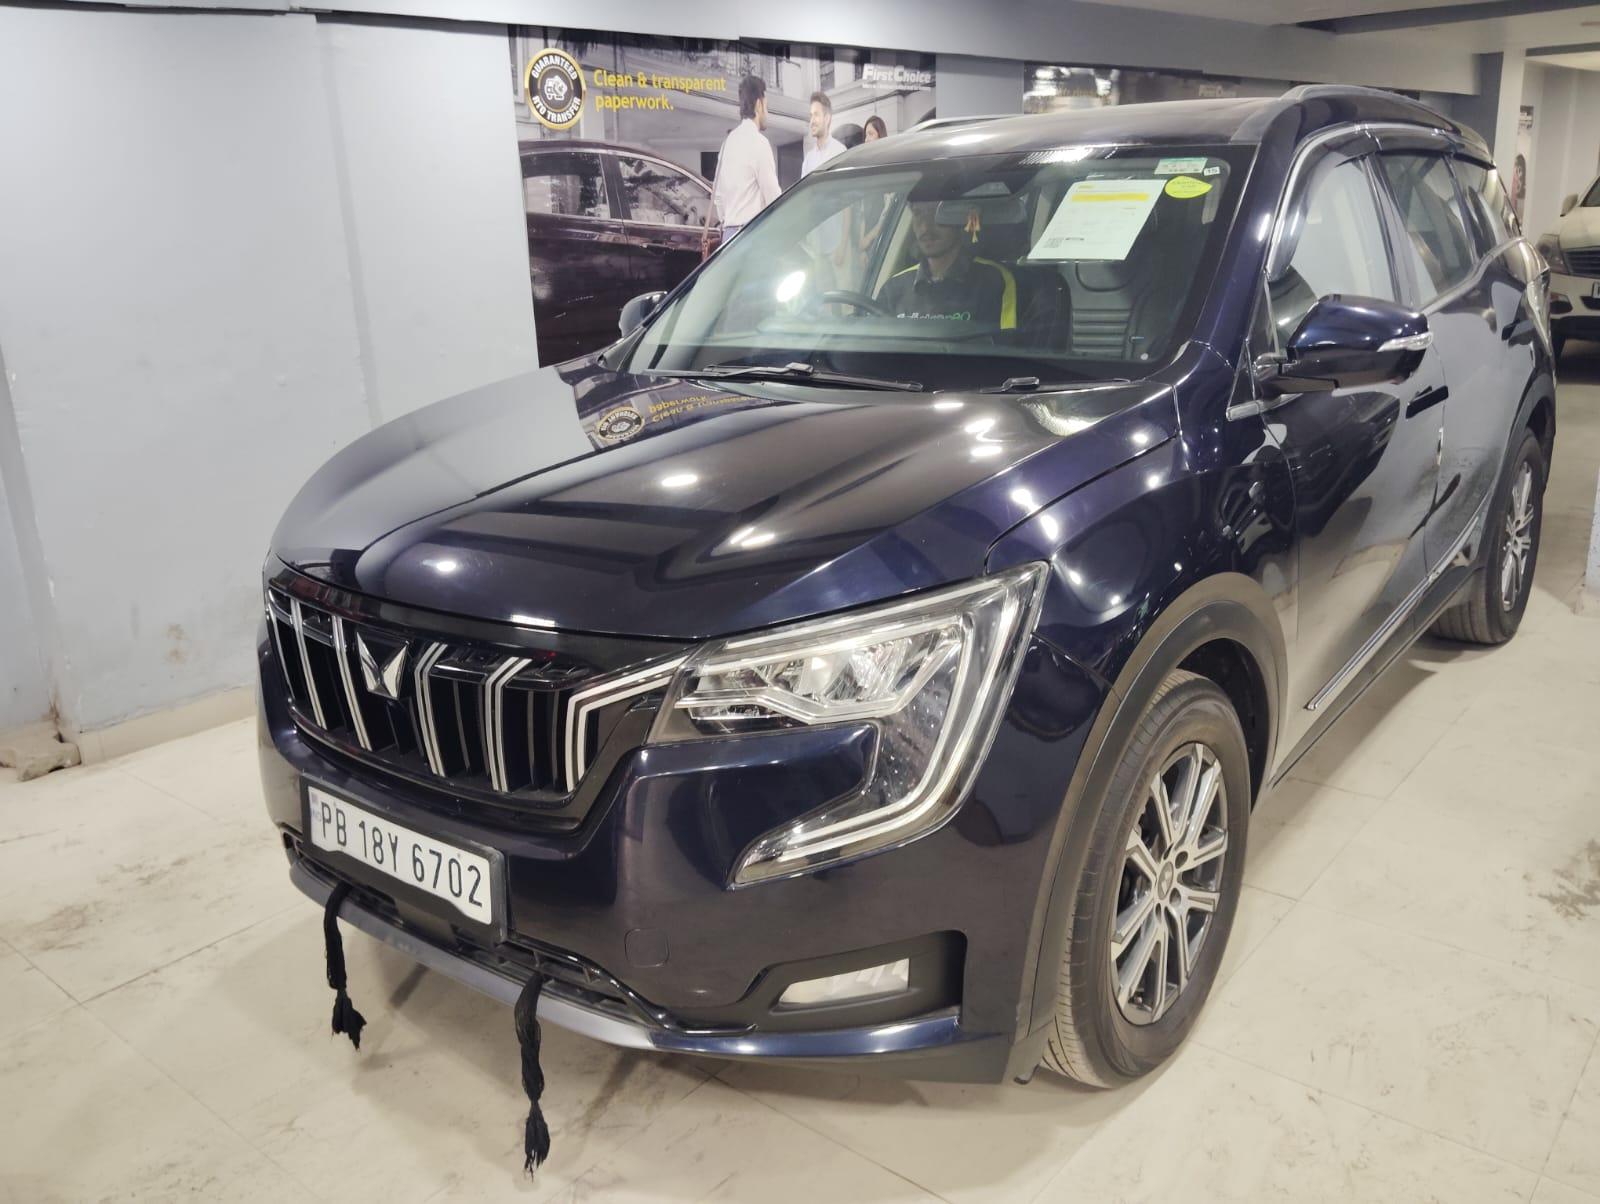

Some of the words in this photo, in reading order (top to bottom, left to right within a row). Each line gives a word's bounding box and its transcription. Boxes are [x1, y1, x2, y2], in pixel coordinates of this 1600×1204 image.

[531, 55, 578, 80] GUARANTEED
[593, 69, 633, 88] Clean
[637, 71, 648, 88] &
[652, 73, 727, 94] transparent
[532, 95, 547, 115] RTO
[547, 96, 581, 123] TRANSFER
[595, 94, 674, 112] paperwork.
[321, 801, 347, 847] PB
[359, 820, 398, 873] 18Y
[412, 843, 483, 908] 6702
